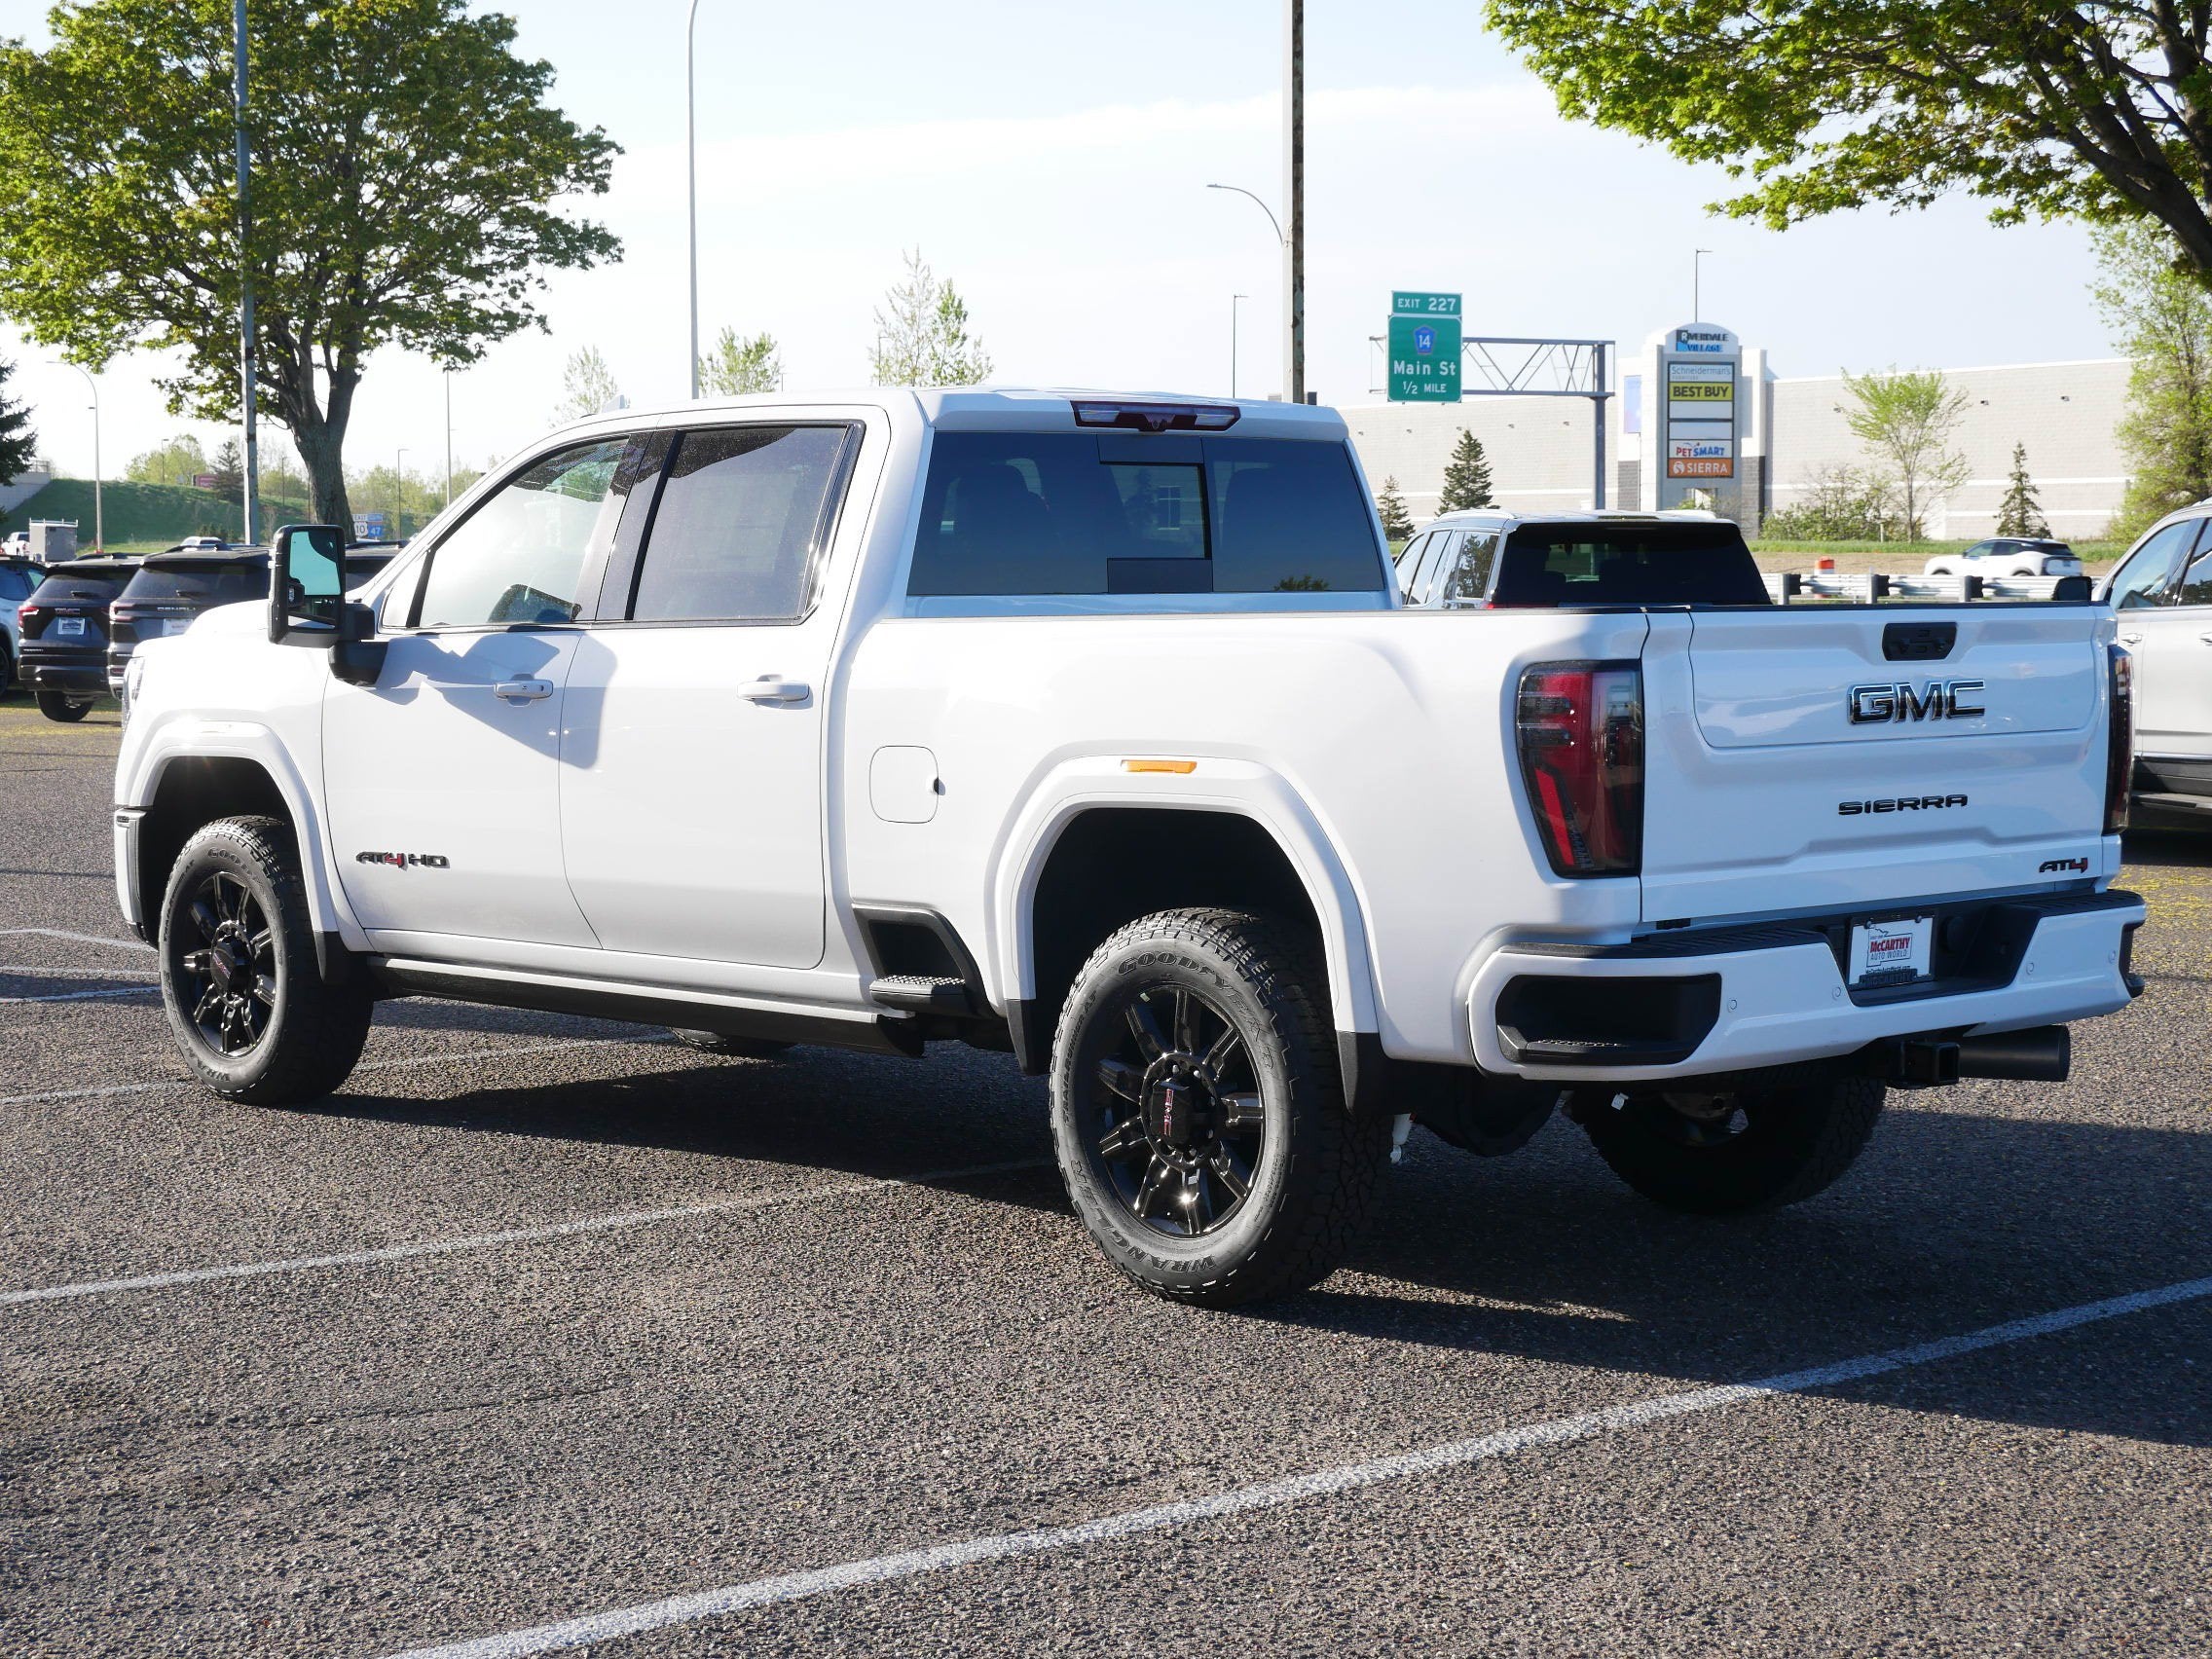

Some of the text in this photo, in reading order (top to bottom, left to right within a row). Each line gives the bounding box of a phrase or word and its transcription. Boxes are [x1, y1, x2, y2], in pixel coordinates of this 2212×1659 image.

[1397, 297, 1457, 312] EXIT 227
[1419, 334, 1431, 349] 14
[1687, 344, 1723, 352] VILLAGE
[1393, 360, 1456, 376] Main St
[1423, 383, 1448, 393] MILE
[1673, 386, 1729, 397] BEST BUY
[1686, 462, 1728, 474] SIERRA
[355, 525, 366, 535] 10
[370, 527, 382, 535] 47
[1847, 679, 1985, 724] GMC
[1838, 793, 1968, 816] SIERRA
[2039, 857, 2088, 874] AT4
[1869, 937, 1911, 953] McCARTHY
[1870, 948, 1908, 961] AUTO WORLD
[1071, 1159, 1217, 1273] WRANGLER
